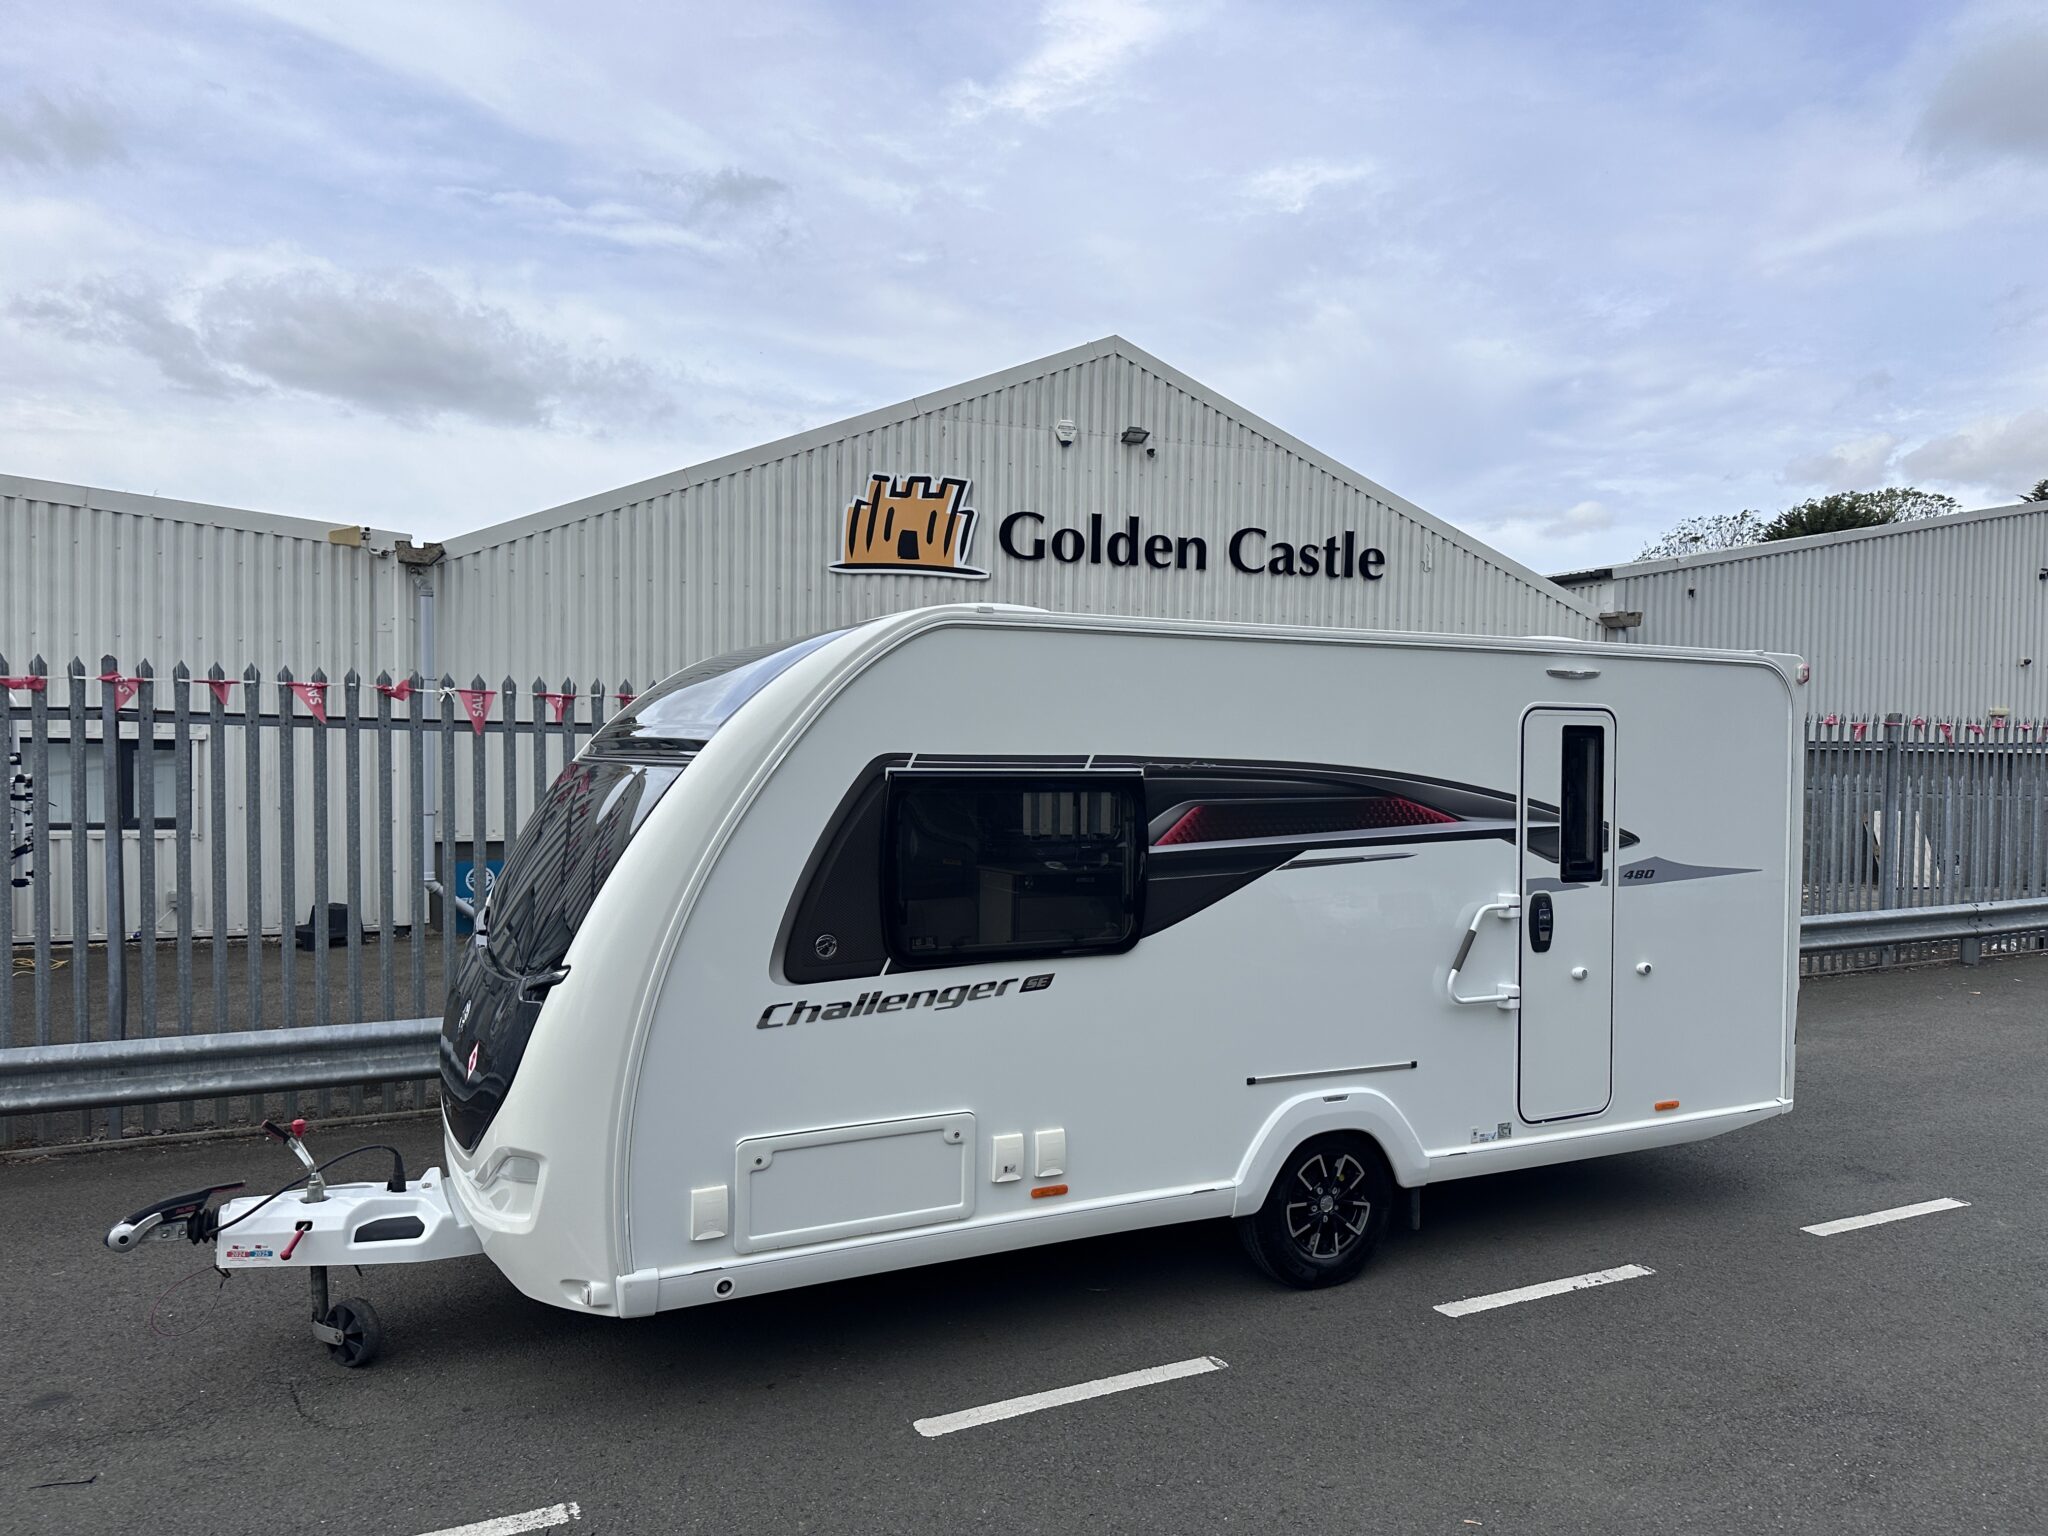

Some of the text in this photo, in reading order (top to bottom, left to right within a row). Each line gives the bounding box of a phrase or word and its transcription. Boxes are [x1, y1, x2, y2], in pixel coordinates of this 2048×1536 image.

[999, 511, 1385, 580] Golden Castle
[1623, 869, 1656, 880] 480
[756, 976, 1051, 1029] Challenger SE
